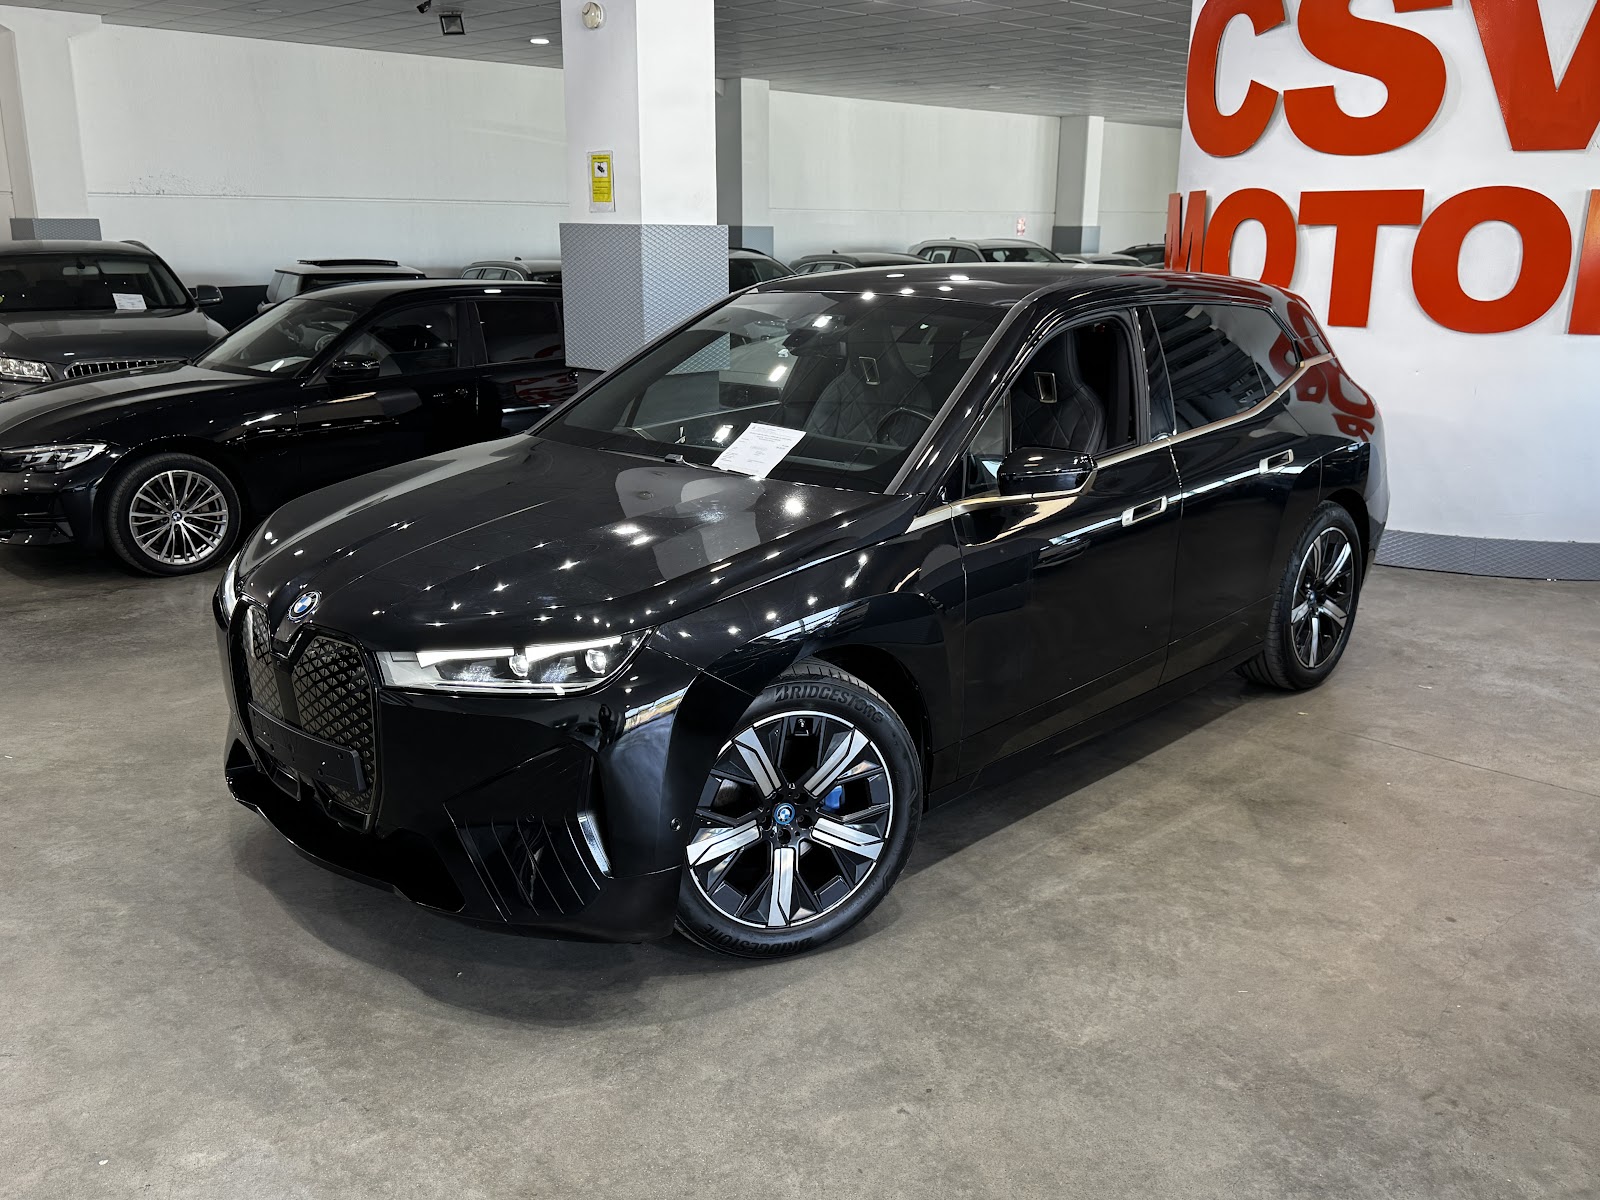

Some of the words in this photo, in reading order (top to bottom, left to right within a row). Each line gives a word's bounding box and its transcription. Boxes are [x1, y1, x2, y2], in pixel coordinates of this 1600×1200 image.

[1187, 0, 1600, 157] CSV
[1165, 185, 1600, 335] MOTO
[775, 685, 884, 723] BRIDGESTONE
